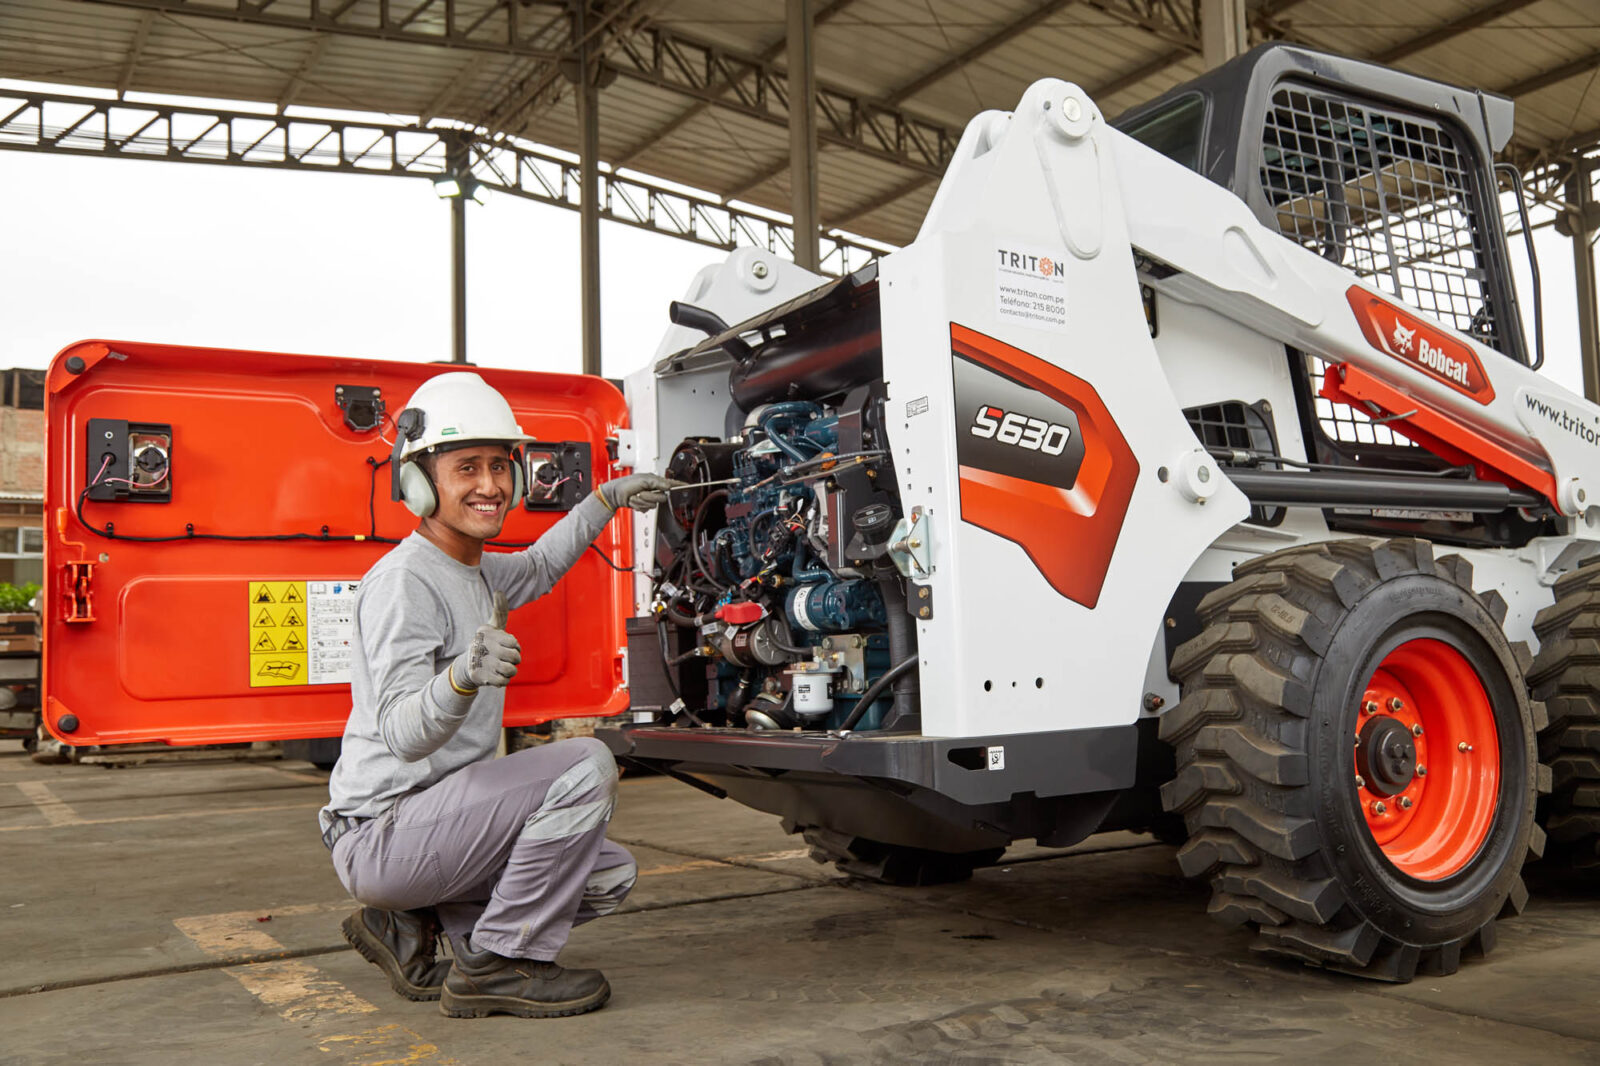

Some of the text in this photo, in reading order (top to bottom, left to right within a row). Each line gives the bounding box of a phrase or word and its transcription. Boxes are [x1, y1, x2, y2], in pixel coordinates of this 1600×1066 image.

[998, 249, 1064, 277] TRITON
[1000, 286, 1064, 304] www.triton.com.pe
[1033, 302, 1045, 312] 215
[1046, 304, 1065, 316] 8000
[1418, 338, 1468, 386] Bobcat
[971, 406, 1071, 456] S630
